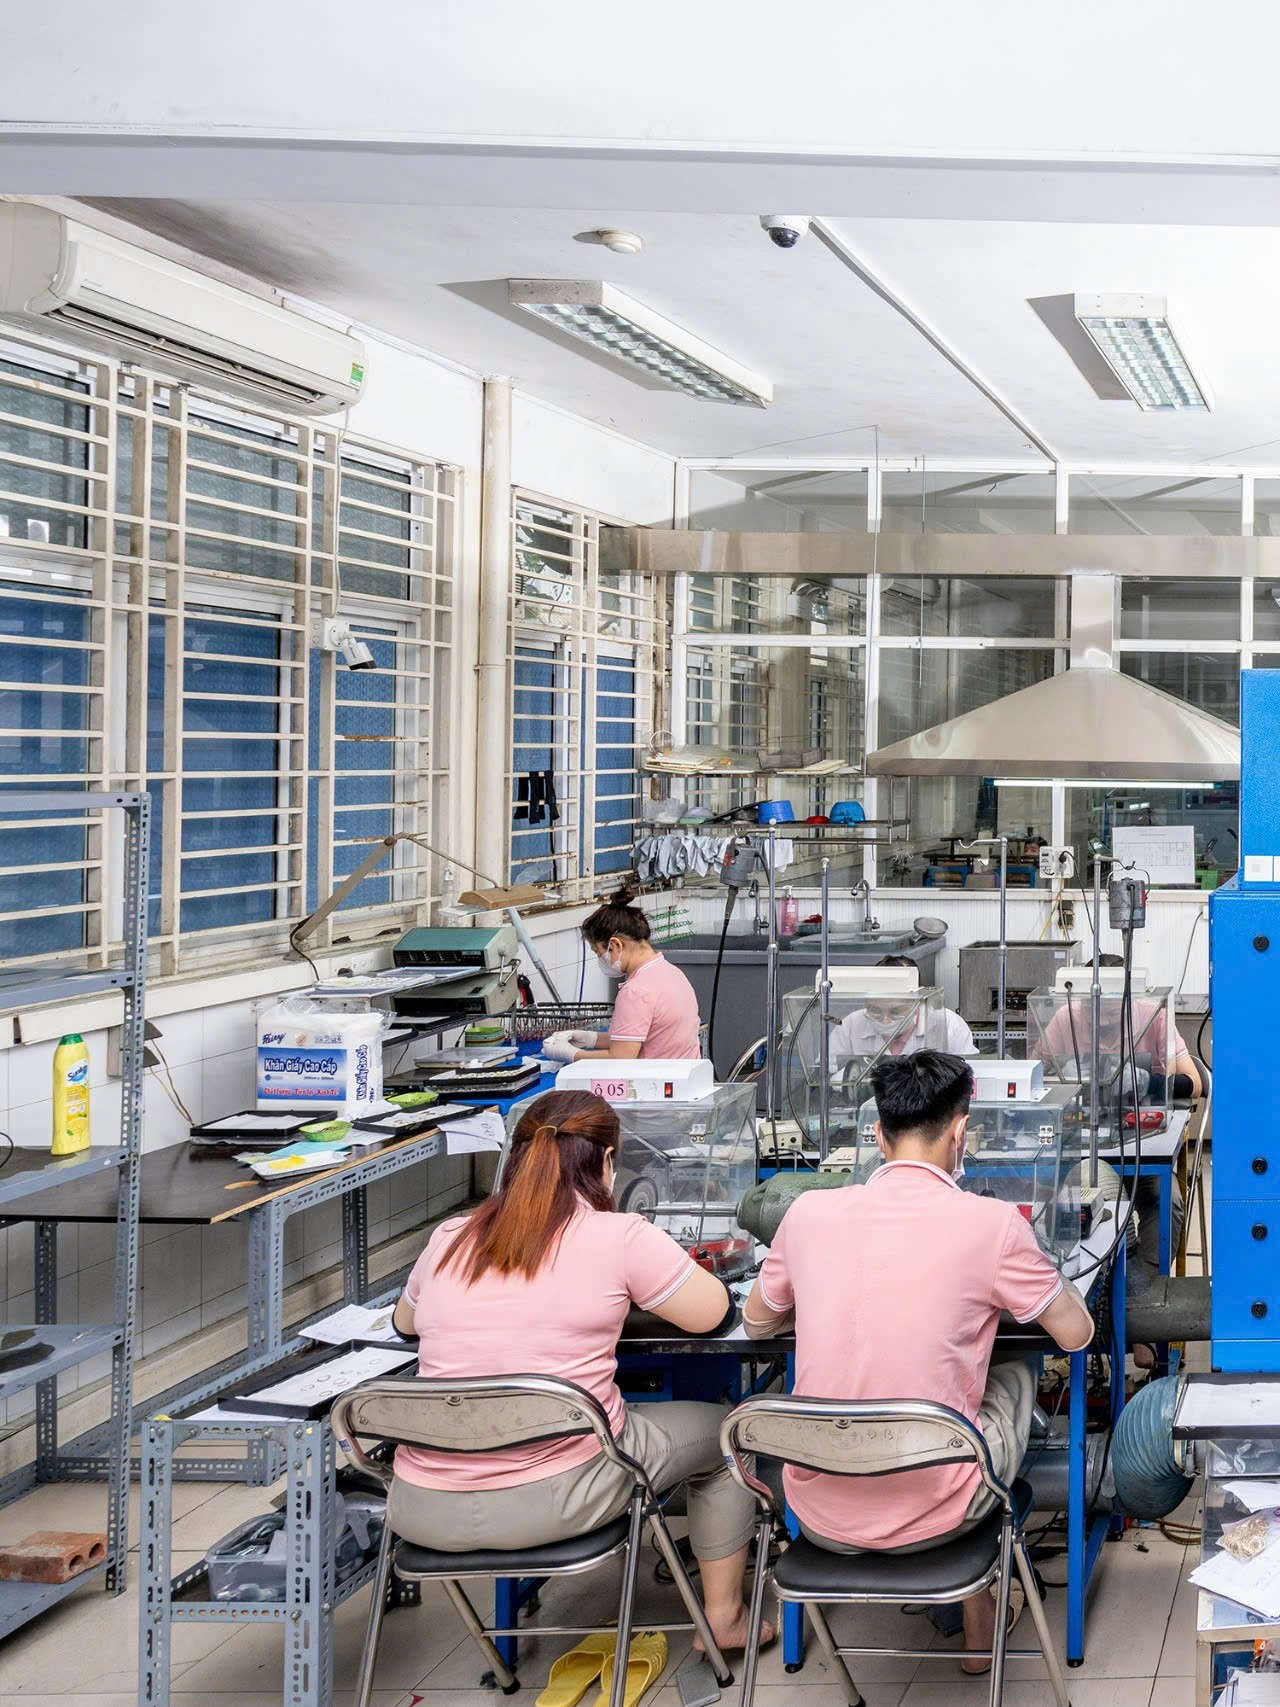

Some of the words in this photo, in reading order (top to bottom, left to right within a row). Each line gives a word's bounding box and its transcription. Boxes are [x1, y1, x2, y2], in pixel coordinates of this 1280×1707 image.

[264, 1058, 285, 1072] Khăn
[286, 1057, 303, 1075] Giấy
[304, 1059, 320, 1073] Cao
[320, 1058, 337, 1075] Cấp
[607, 1083, 624, 1096] 05
